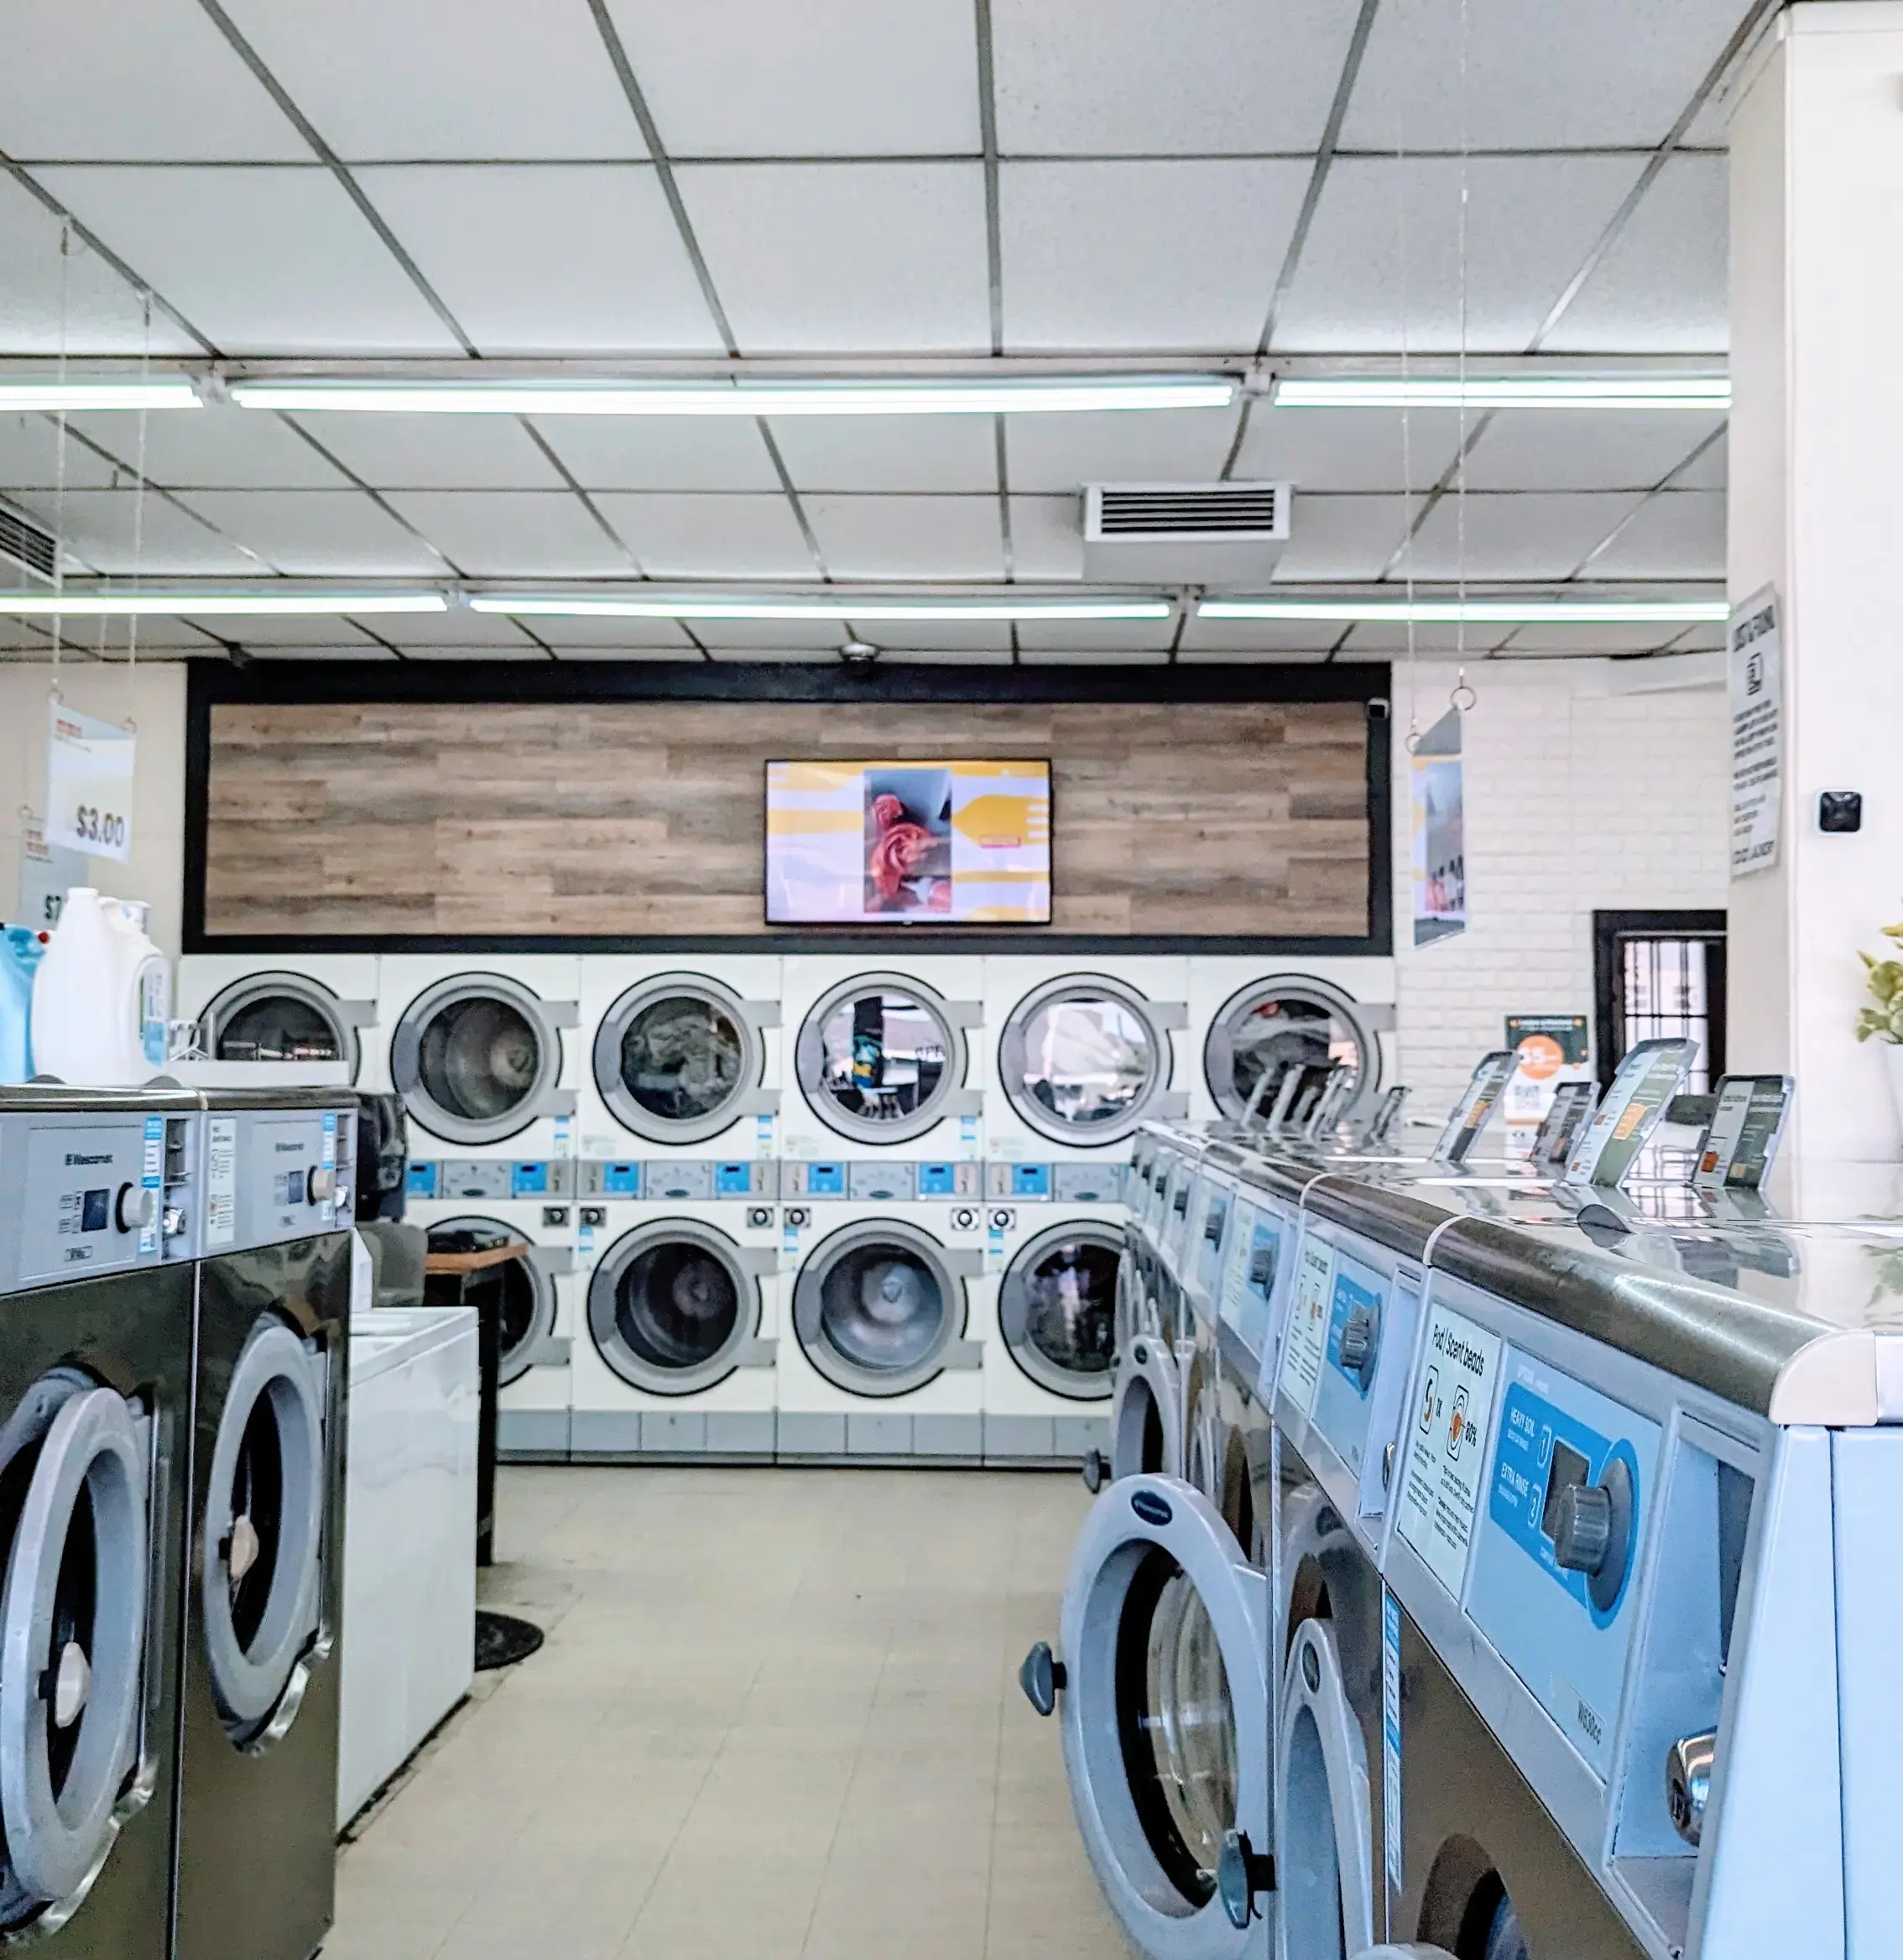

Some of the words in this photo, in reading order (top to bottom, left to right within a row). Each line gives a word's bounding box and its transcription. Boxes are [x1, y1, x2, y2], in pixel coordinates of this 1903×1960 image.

[77, 805, 124, 847] $3.00
[1447, 1332, 1465, 1363] Scent
[1463, 1341, 1484, 1376] beads
